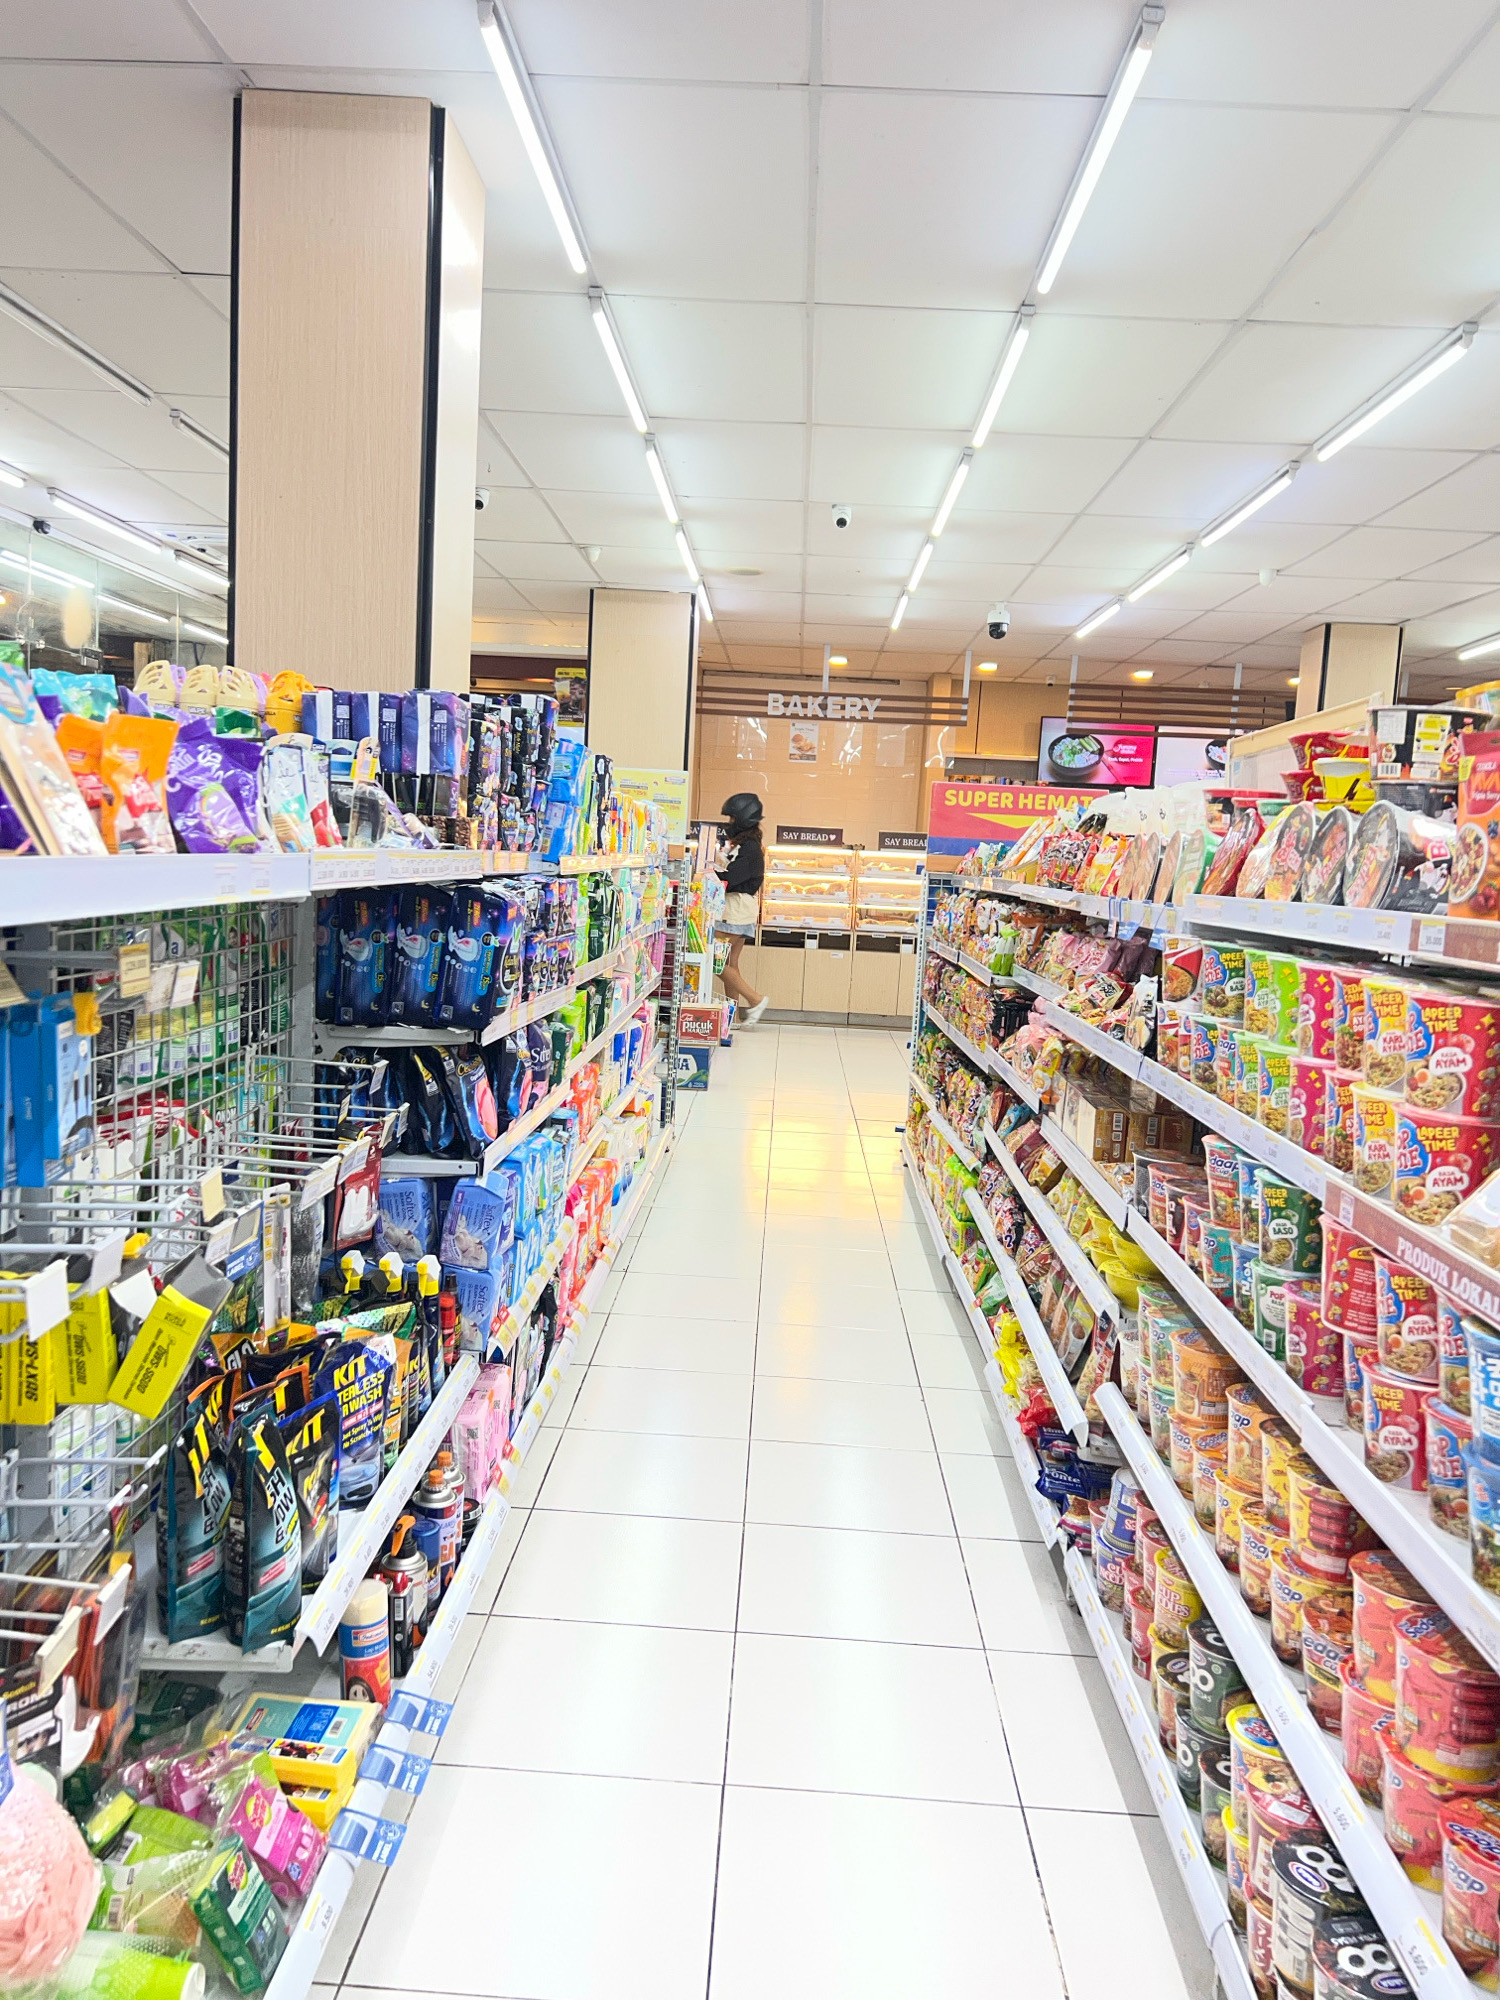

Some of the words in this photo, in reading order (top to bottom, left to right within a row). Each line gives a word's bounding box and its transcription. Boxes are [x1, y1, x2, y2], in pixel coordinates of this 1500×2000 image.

[768, 693, 881, 720] BAKERY
[944, 790, 1013, 809] SUPER
[1018, 793, 1094, 811] HEMAT
[783, 832, 799, 840] SAY
[801, 832, 829, 841] BREAD
[884, 838, 900, 846] SAY
[1223, 961, 1244, 969] TIME
[1375, 1004, 1401, 1017] TIME
[1422, 1006, 1463, 1022] LAPEER
[682, 1020, 713, 1033] pucuk
[1426, 1020, 1459, 1033] TIME
[1383, 1035, 1402, 1044] KARI
[1383, 1043, 1405, 1053] AYAM
[1436, 1058, 1467, 1069] AYAM
[1417, 1126, 1459, 1141] LAPEER
[1368, 1143, 1387, 1152] KARI
[1422, 1139, 1456, 1152] TIME
[1368, 1151, 1391, 1160] AYAM
[1433, 1176, 1464, 1188] AYAM
[405, 1191, 416, 1221] Softex
[1266, 1198, 1286, 1207] TIME
[482, 1205, 496, 1233] Softex
[1273, 1227, 1293, 1235] BASO
[1396, 1236, 1450, 1287] PRODUK
[227, 1263, 244, 1278] LABEL
[479, 1285, 489, 1313] Softex
[1396, 1289, 1427, 1300] TIME
[333, 1354, 368, 1390] KIT
[337, 1369, 385, 1405] TERLESS
[1376, 1398, 1402, 1412] TIME
[1383, 1435, 1413, 1446] AYAM
[430, 1717, 443, 1735] LABEL
[408, 1774, 420, 1792] LABEL
[379, 1842, 393, 1864] LABEL
